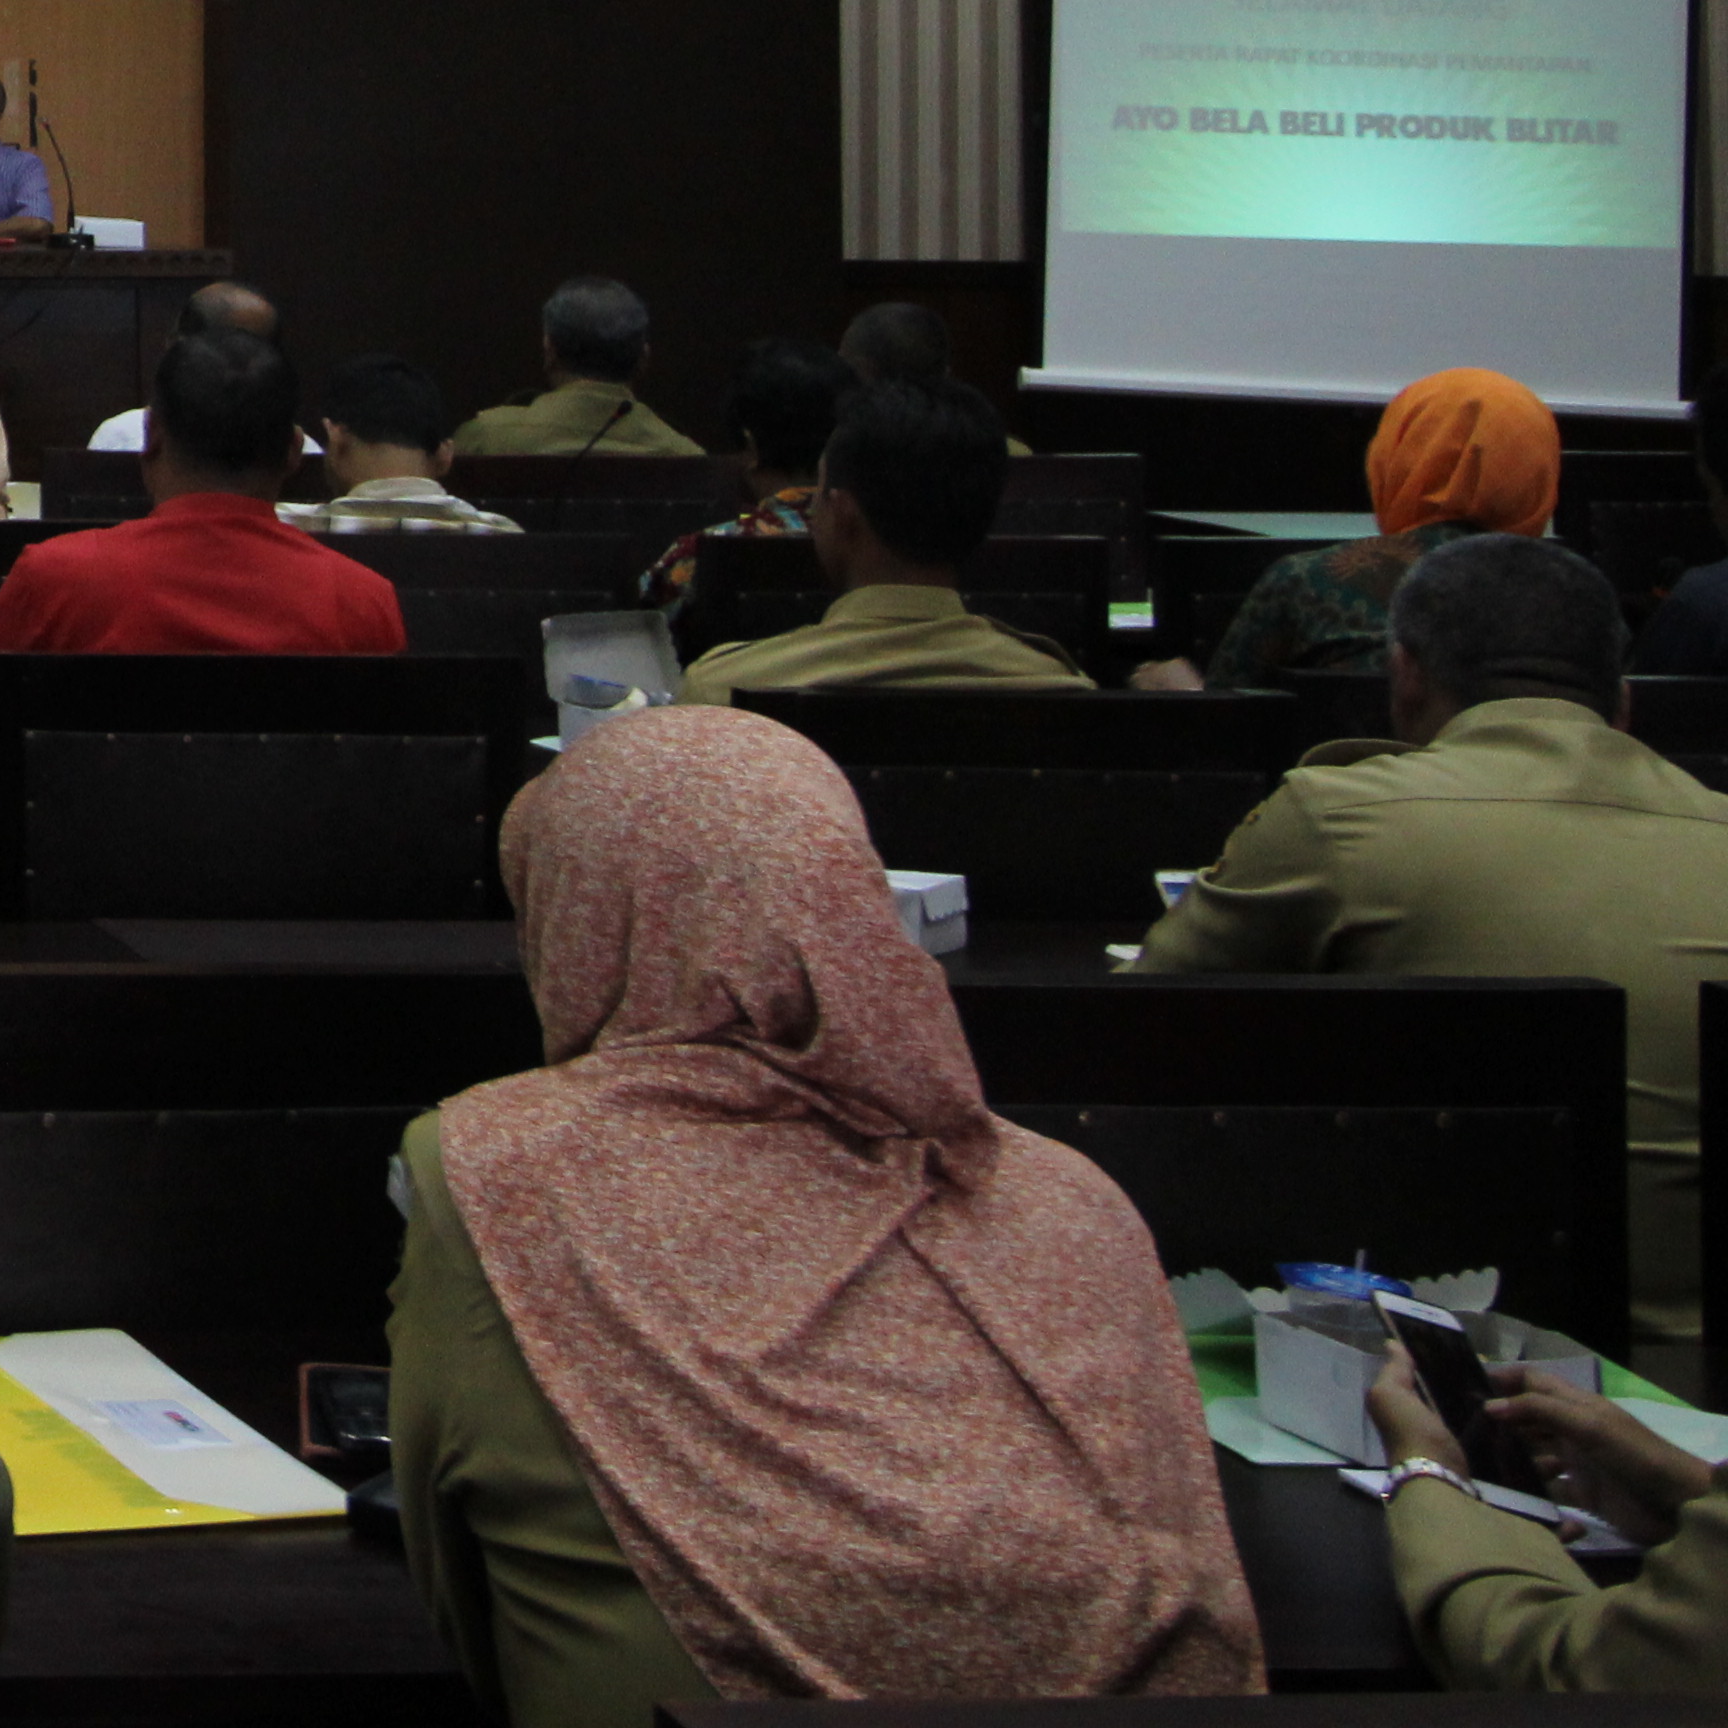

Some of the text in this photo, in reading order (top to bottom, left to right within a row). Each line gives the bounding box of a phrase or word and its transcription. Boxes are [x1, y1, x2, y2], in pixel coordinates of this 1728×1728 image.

[1111, 105, 1621, 148] AYO BELA BELI PRODUK BLITAR
